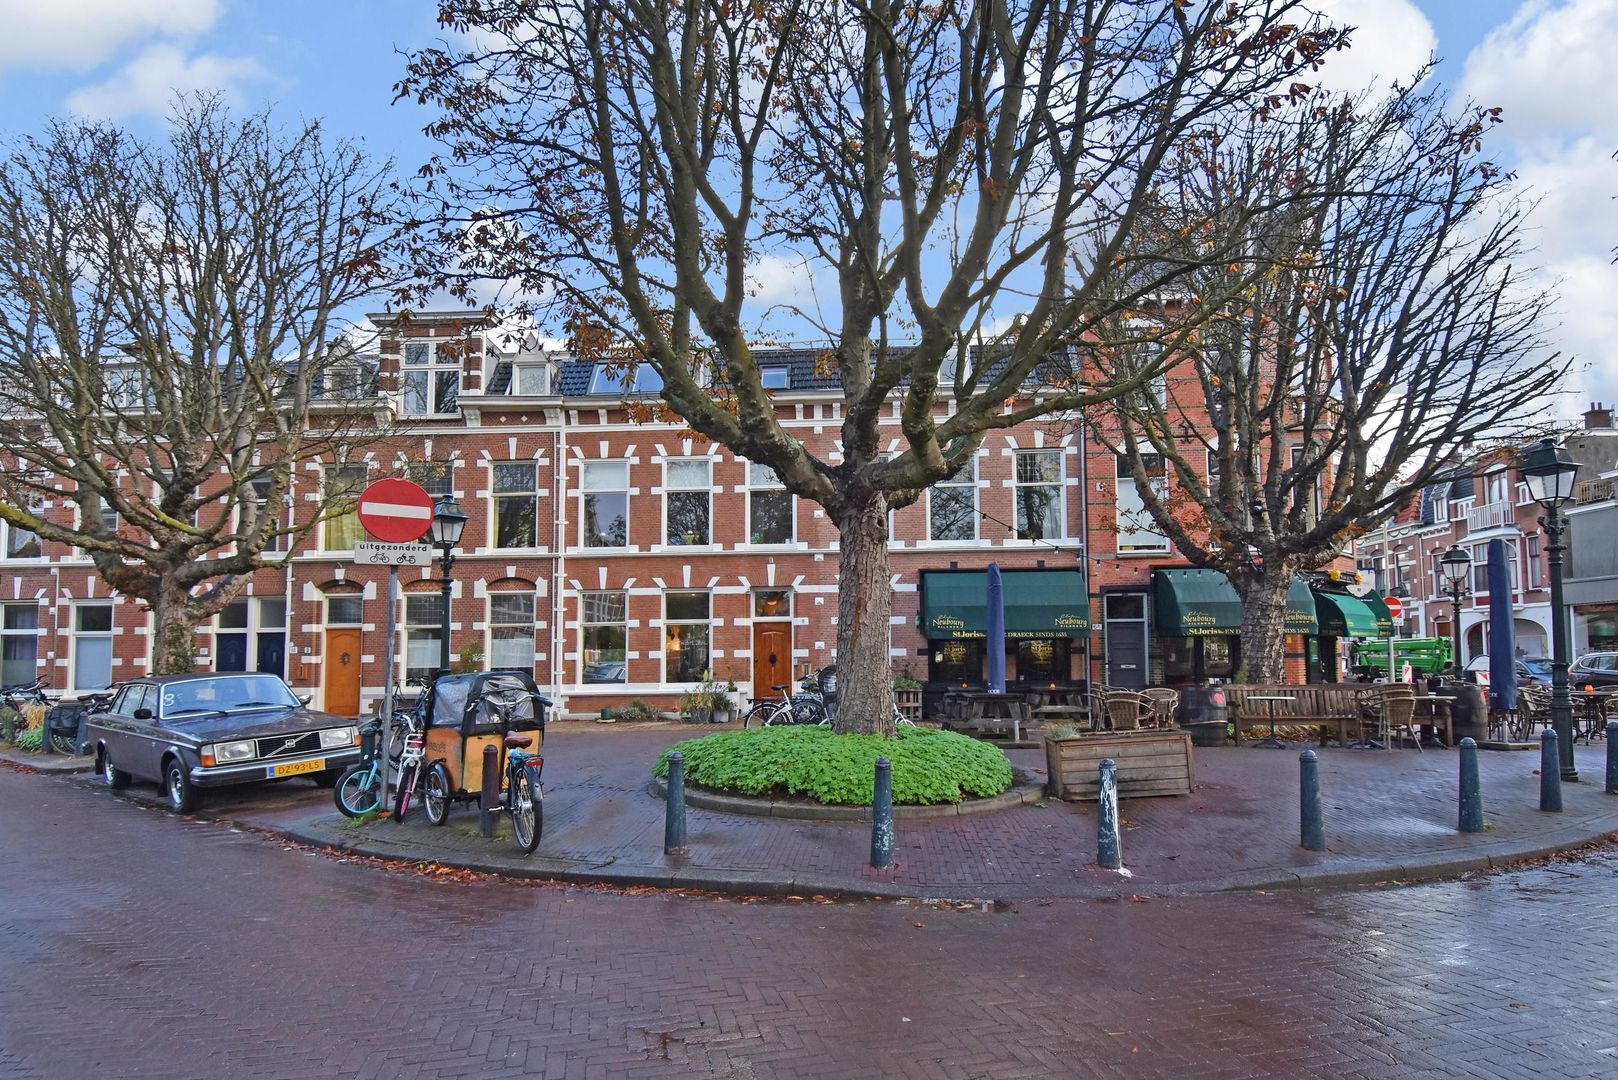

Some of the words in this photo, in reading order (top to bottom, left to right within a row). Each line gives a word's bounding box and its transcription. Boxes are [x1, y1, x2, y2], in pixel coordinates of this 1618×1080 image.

[359, 543, 427, 552] uitgezonderd
[932, 617, 964, 629] Neubourg
[1055, 616, 1087, 628] Neubourg
[1182, 614, 1216, 625] Neubourg
[278, 761, 320, 775] DZ-93-LS
